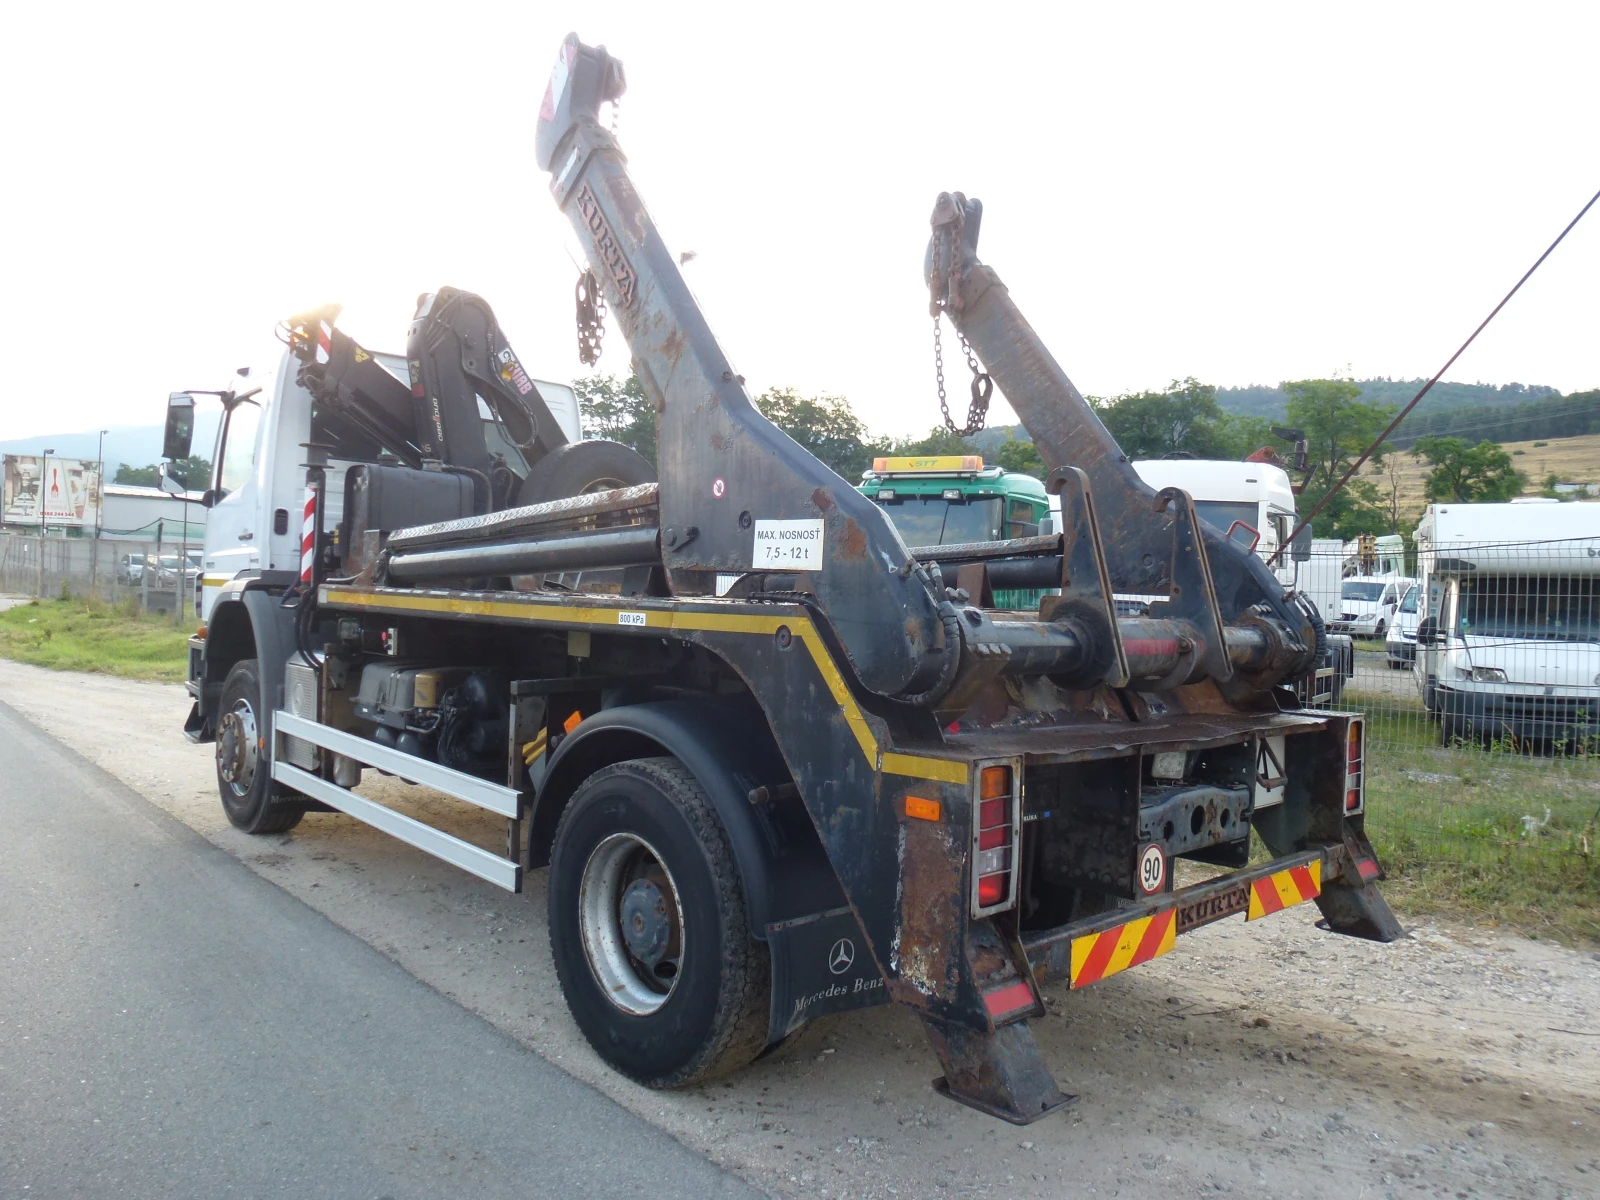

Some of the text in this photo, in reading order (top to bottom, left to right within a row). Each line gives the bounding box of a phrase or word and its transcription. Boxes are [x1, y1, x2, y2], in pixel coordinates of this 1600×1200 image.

[915, 459, 939, 467] STT
[757, 527, 821, 540] MAX. NOSNOSŤ
[766, 546, 780, 561] 7,5
[790, 546, 802, 559] 12
[804, 547, 809, 559] t
[619, 614, 644, 625] 800 kPa
[1144, 856, 1160, 883] 90
[1179, 886, 1249, 927] KURTA
[793, 977, 884, 1012] Mercedes Benz
